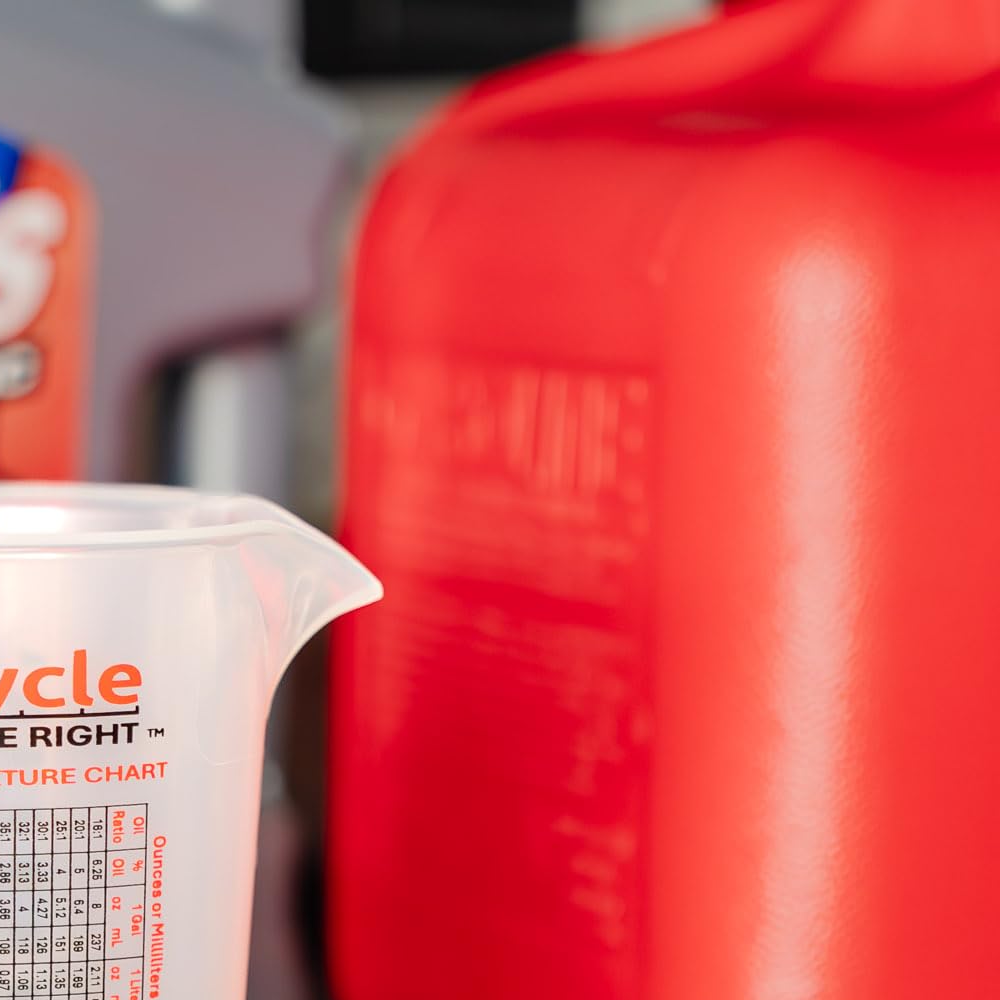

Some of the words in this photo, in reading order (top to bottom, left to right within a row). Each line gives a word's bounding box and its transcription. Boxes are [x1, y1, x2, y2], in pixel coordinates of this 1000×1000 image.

[29, 723, 138, 748] RIGHT
[84, 762, 168, 784] CHART
[18, 822, 30, 841] 32:1
[37, 821, 49, 841] 30:1
[56, 820, 67, 840] 25:1
[74, 820, 85, 840] 20:1
[113, 811, 125, 843] Ratio
[133, 817, 144, 834] Oil
[37, 862, 48, 883] 3.33
[113, 859, 124, 876] Oil
[133, 860, 143, 871] %
[152, 836, 166, 898] Ounces
[37, 898, 48, 919] 4.27
[112, 897, 120, 910] oz
[152, 903, 161, 919] or
[131, 915, 142, 936] Gal
[91, 934, 102, 951] 237
[112, 928, 122, 946] mL
[150, 924, 164, 998] Milliliters
[36, 970, 47, 990] 1.13
[90, 966, 101, 986] 2.11
[111, 967, 120, 980] oz
